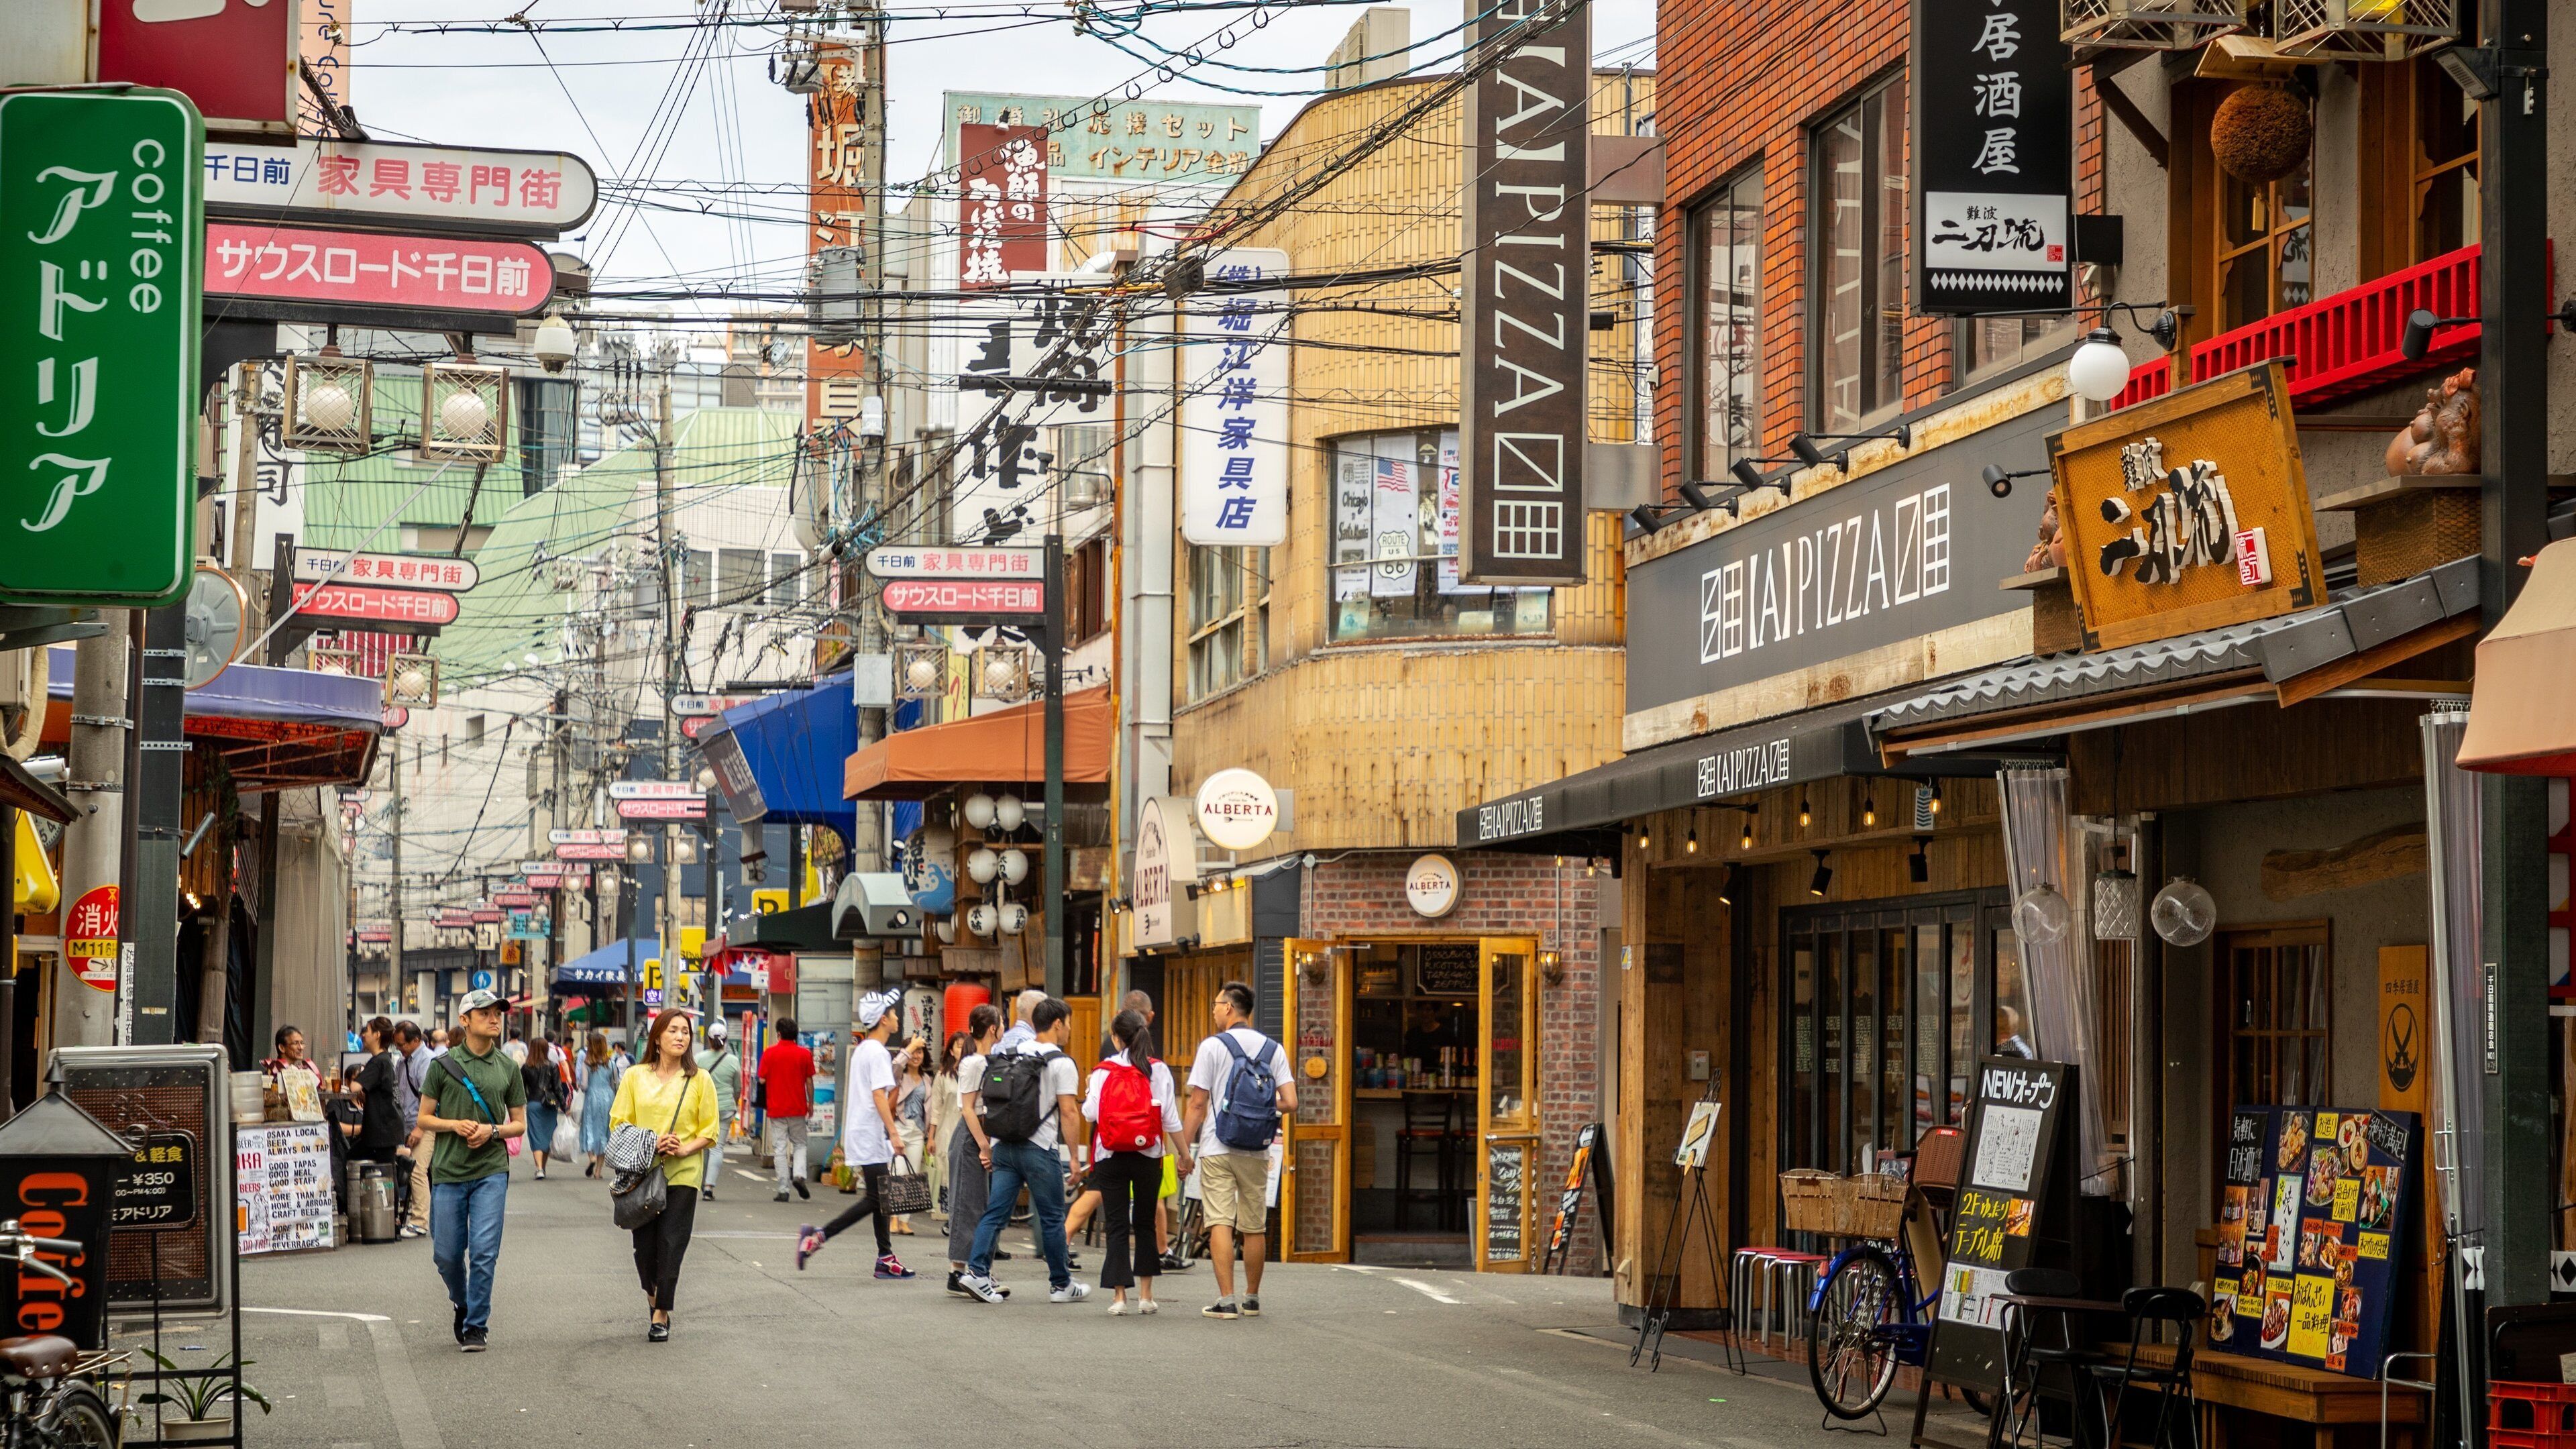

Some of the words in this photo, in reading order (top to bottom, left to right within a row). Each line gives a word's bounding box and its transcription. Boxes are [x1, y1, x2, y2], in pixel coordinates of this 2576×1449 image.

[205, 155, 289, 185] 千日前
[317, 156, 562, 209] 家具専門街
[1967, 206, 1998, 221] 難波
[129, 138, 172, 313] coffee
[1932, 217, 2045, 252] 二刀流
[216, 239, 530, 297] サウスロード千日前
[20, 164, 119, 532] アドリア
[1382, 535, 1405, 545] ROUTE
[877, 554, 915, 568] 千日前
[923, 551, 1029, 573] 家具専門街
[1385, 561, 1405, 574] 66
[353, 558, 462, 584] 家具専門街
[891, 586, 1038, 608] サウスロード千日前
[640, 785, 692, 794] 家具専門
[1204, 803, 1273, 816] ALBERTA
[1135, 863, 1170, 910] ALBERTA
[1409, 881, 1451, 891] ALBERTA
[267, 1129, 290, 1139] OSAKA
[295, 1128, 319, 1137] LOCAL
[267, 1139, 286, 1147] BEER
[150, 1146, 183, 1163] 軽食
[268, 1146, 297, 1157] ALWAYS
[301, 1145, 311, 1154] ON
[315, 1144, 329, 1153] TAP
[268, 1161, 289, 1171] GOOD
[294, 1160, 317, 1169] TAPAS
[133, 1172, 174, 1186] ¥350
[268, 1169, 288, 1179] GOOD
[294, 1169, 313, 1177] MEAL
[239, 1183, 261, 1193] BEERS
[269, 1178, 289, 1188] GOOD
[294, 1177, 318, 1185] STAFF
[270, 1193, 290, 1201] MORE
[296, 1191, 315, 1200] THAN
[271, 1201, 292, 1210] HOME
[305, 1199, 332, 1208] ABROAD
[272, 1210, 297, 1219] CRAFT
[301, 1208, 320, 1217] BEER
[272, 1224, 292, 1234] MORE
[296, 1223, 315, 1232] THAN
